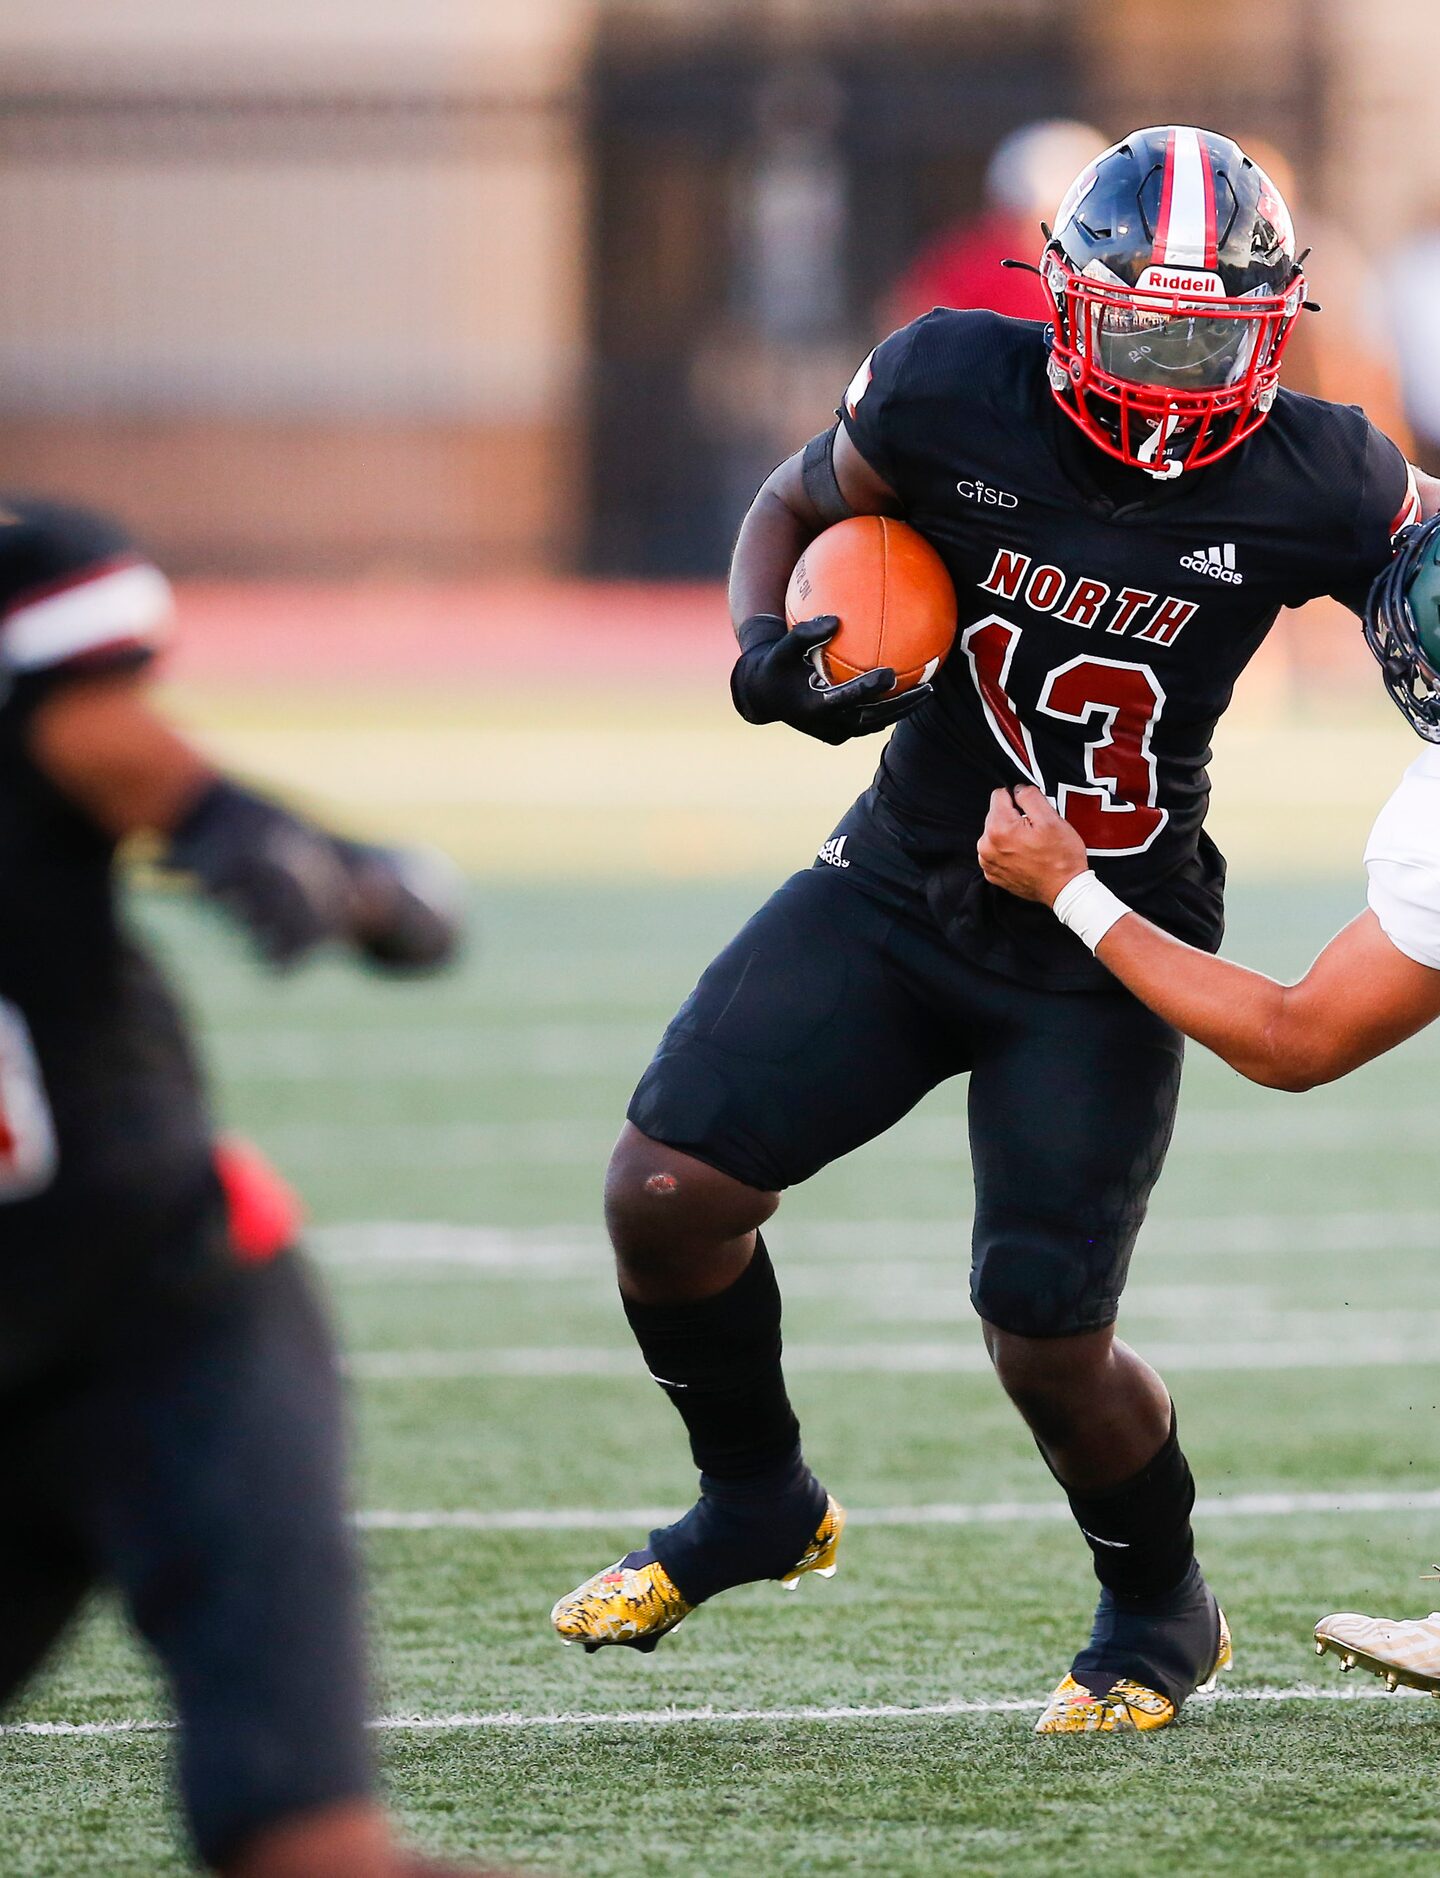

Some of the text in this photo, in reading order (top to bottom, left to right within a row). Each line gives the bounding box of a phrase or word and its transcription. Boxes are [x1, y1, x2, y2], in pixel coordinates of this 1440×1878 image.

[1149, 271, 1216, 292] Riddell
[977, 548, 1200, 648] NORTH
[1179, 555, 1243, 585] adidas
[960, 613, 1169, 857] 13
